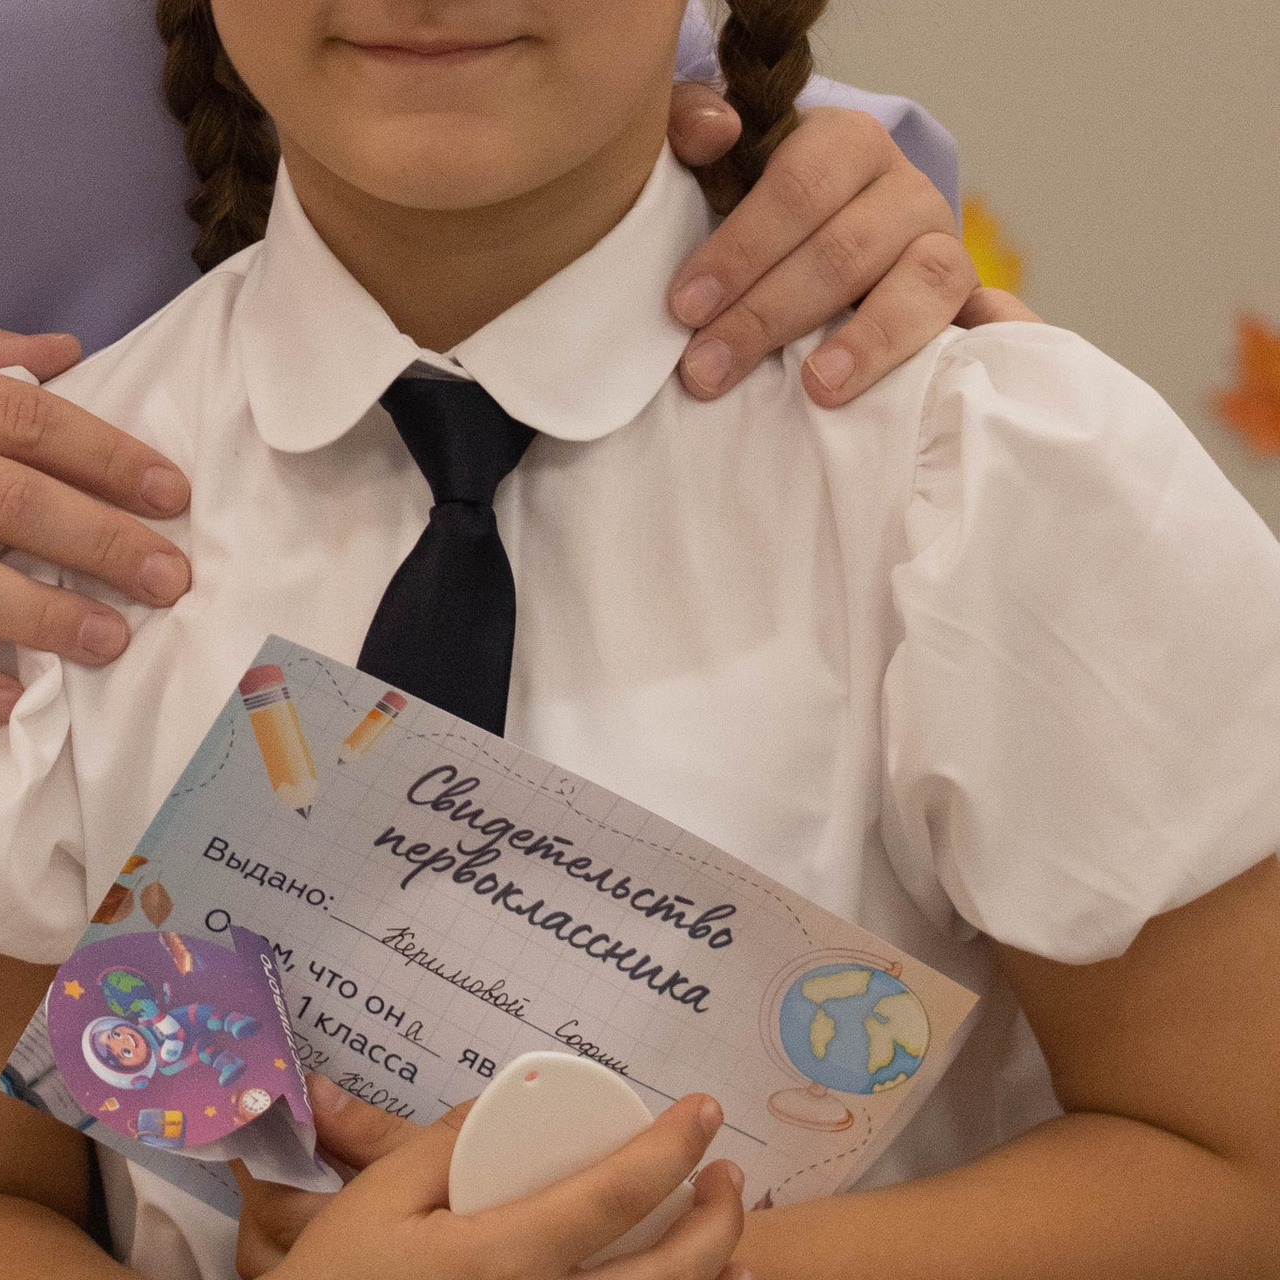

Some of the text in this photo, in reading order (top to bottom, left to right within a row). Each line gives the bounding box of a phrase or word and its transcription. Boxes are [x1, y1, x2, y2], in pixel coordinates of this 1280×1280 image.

[203, 836, 334, 911] Выдано:
[381, 926, 530, 1018] Керимовой
[374, 826, 710, 1013] первоклассника
[407, 764, 737, 949] Свидетельство
[297, 995, 419, 1084] 1 класса
[309, 960, 358, 999] что
